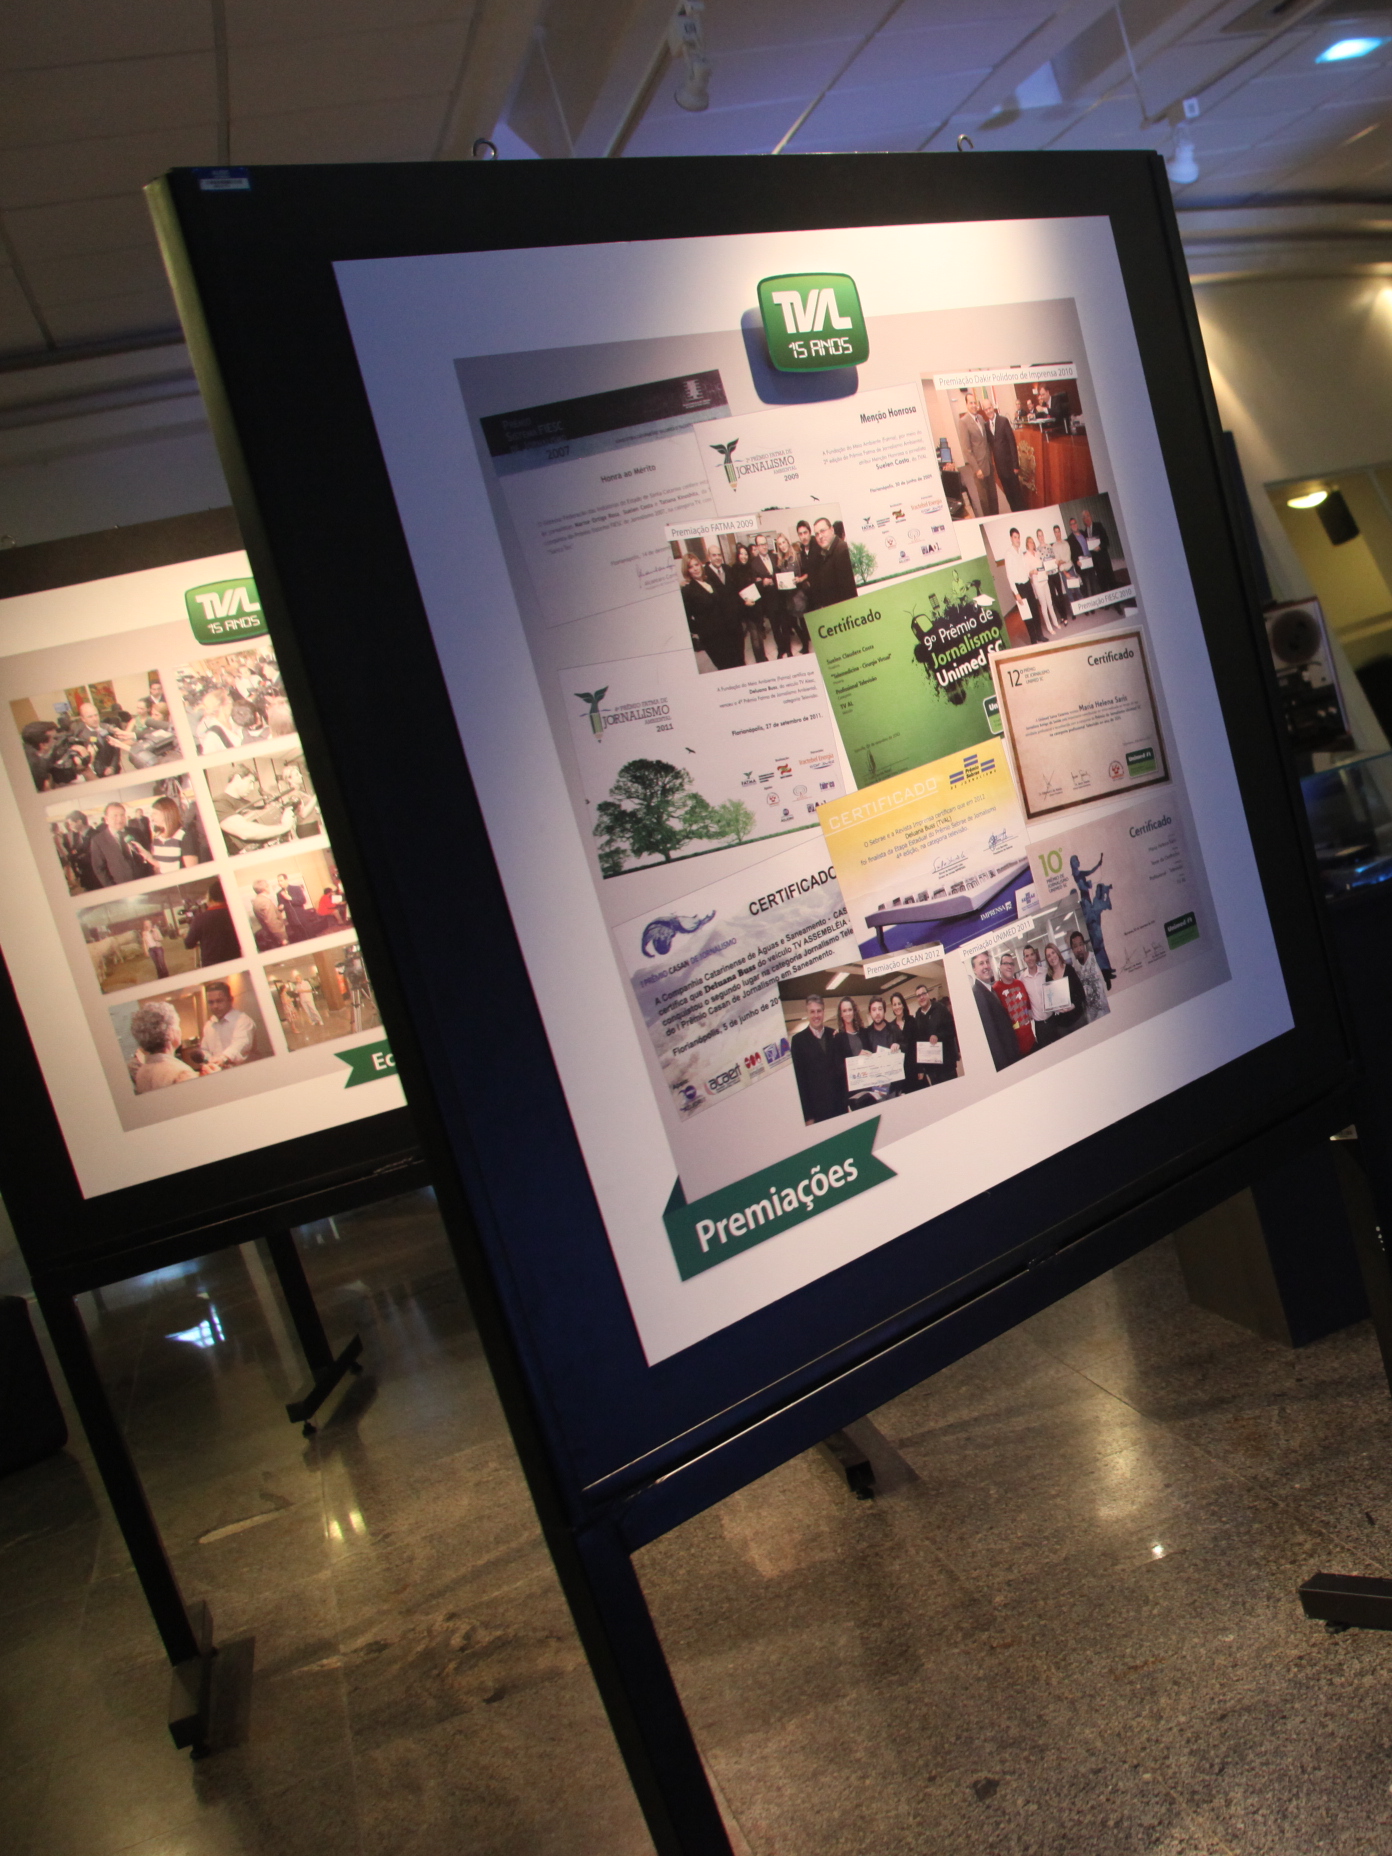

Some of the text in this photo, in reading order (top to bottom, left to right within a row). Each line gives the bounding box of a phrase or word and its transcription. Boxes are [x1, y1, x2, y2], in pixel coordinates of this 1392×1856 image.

[789, 337, 853, 358] 15 ANOS
[938, 374, 974, 387] Premiação
[992, 371, 1019, 382] Polidoro
[1019, 370, 1028, 379] de
[1028, 369, 1058, 380] Imprensa
[1058, 367, 1073, 377] 2010
[860, 406, 917, 424] Menção Honrosa
[545, 445, 570, 460] 2007
[600, 464, 657, 484] Honra ao Mérito
[735, 456, 795, 479] JORNALISMO
[784, 472, 799, 482] 2009
[875, 461, 894, 470] Suelen
[671, 519, 754, 537] Premiação FATMA 2009
[1077, 596, 1105, 611] Premiação
[1119, 588, 1132, 598] 2010
[208, 615, 261, 634] 15 ANOS
[817, 609, 882, 639] Certificado
[938, 616, 977, 643] Prêmio
[978, 607, 994, 624] de
[931, 626, 1000, 669] Jornalismo
[1087, 648, 1135, 667] Certificado
[936, 648, 987, 687] Unimed
[1094, 699, 1114, 708] Helena
[602, 704, 670, 729] JORNALISMO
[656, 723, 674, 732] 2011
[780, 717, 802, 727] setembro
[829, 777, 937, 830] CERTIFICADO
[869, 834, 886, 846] Sebrae
[895, 824, 912, 835] Revista
[912, 815, 934, 828] Imprensa
[934, 805, 956, 819] certificam
[956, 803, 966, 811] que
[974, 794, 986, 803] 2012
[905, 827, 924, 840] Deluana
[924, 823, 936, 832] Buss
[1129, 814, 1172, 838] Certificado
[867, 851, 887, 863] finalista
[894, 843, 908, 854] Etapa
[908, 834, 928, 847] Estadual
[935, 824, 951, 835] Prêmio
[951, 818, 967, 828] Sebrae
[974, 806, 997, 819] Jornalismo
[927, 835, 948, 848] categoria
[748, 865, 837, 916] CERTIFICADO
[980, 904, 1006, 921] IMPRENSA
[1167, 919, 1187, 933] Unimed
[962, 920, 1031, 957] Premiação UNIMED 2011
[644, 937, 737, 986] PRÊMIO CASAN DE JORNALISMO
[654, 997, 661, 1006] A
[661, 977, 704, 1002] Companhia
[704, 957, 746, 981] Catarinense
[747, 952, 756, 961] de
[757, 940, 780, 956] Águas
[785, 918, 827, 942] Saneamento
[658, 919, 848, 1016] certifica que Deluana Buss do veículo TV ASSEMBLÉIA
[866, 949, 940, 975] Premiação CASAN 2012
[662, 1002, 703, 1027] conquistou
[710, 983, 741, 1002] segundo
[741, 972, 760, 987] lugar
[761, 968, 771, 977] na
[771, 951, 803, 974] categoria
[803, 934, 840, 958] Jornalismo
[839, 928, 854, 939] Tele
[665, 1026, 676, 1037] do
[681, 1010, 708, 1029] Prêmio
[707, 1000, 731, 1015] Casan
[731, 994, 741, 1004] de
[741, 974, 780, 999] Jornalismo
[780, 968, 793, 979] em
[792, 948, 836, 973] Saneamento.
[672, 1027, 723, 1057] Florianópolis,
[722, 1022, 729, 1031] 5
[729, 1018, 739, 1028] de
[738, 1008, 760, 1025] junho
[760, 1003, 770, 1012] de
[708, 1062, 742, 1090] acaert
[695, 1157, 859, 1253] Premiações
